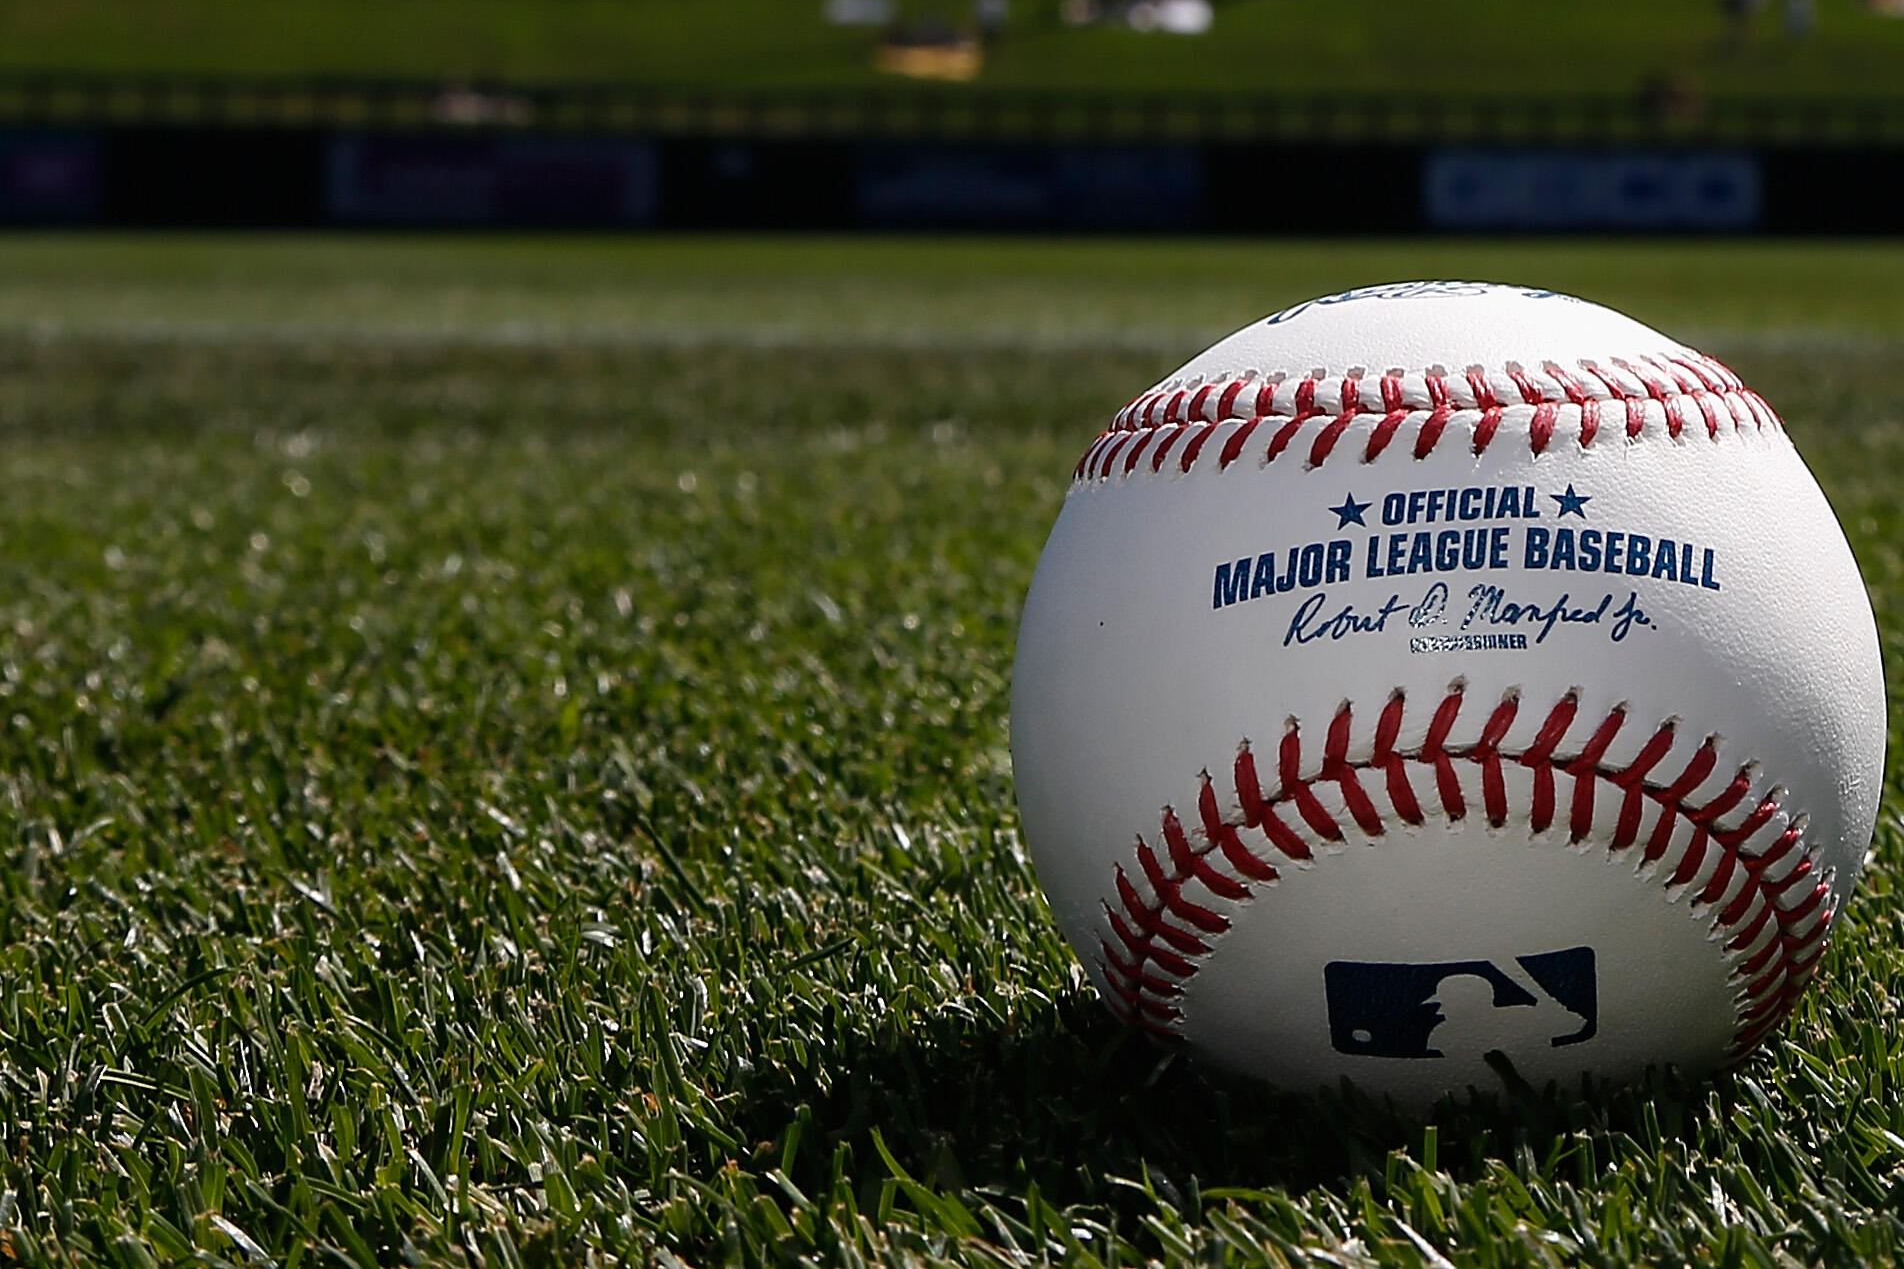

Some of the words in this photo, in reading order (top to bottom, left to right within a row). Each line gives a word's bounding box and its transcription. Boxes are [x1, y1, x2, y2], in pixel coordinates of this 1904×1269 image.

[1382, 487, 1541, 525] OFFICIAL
[1213, 540, 1352, 609] MAJOR
[1366, 527, 1510, 578] LEAGUE
[1523, 528, 1720, 590] BASEBALL
